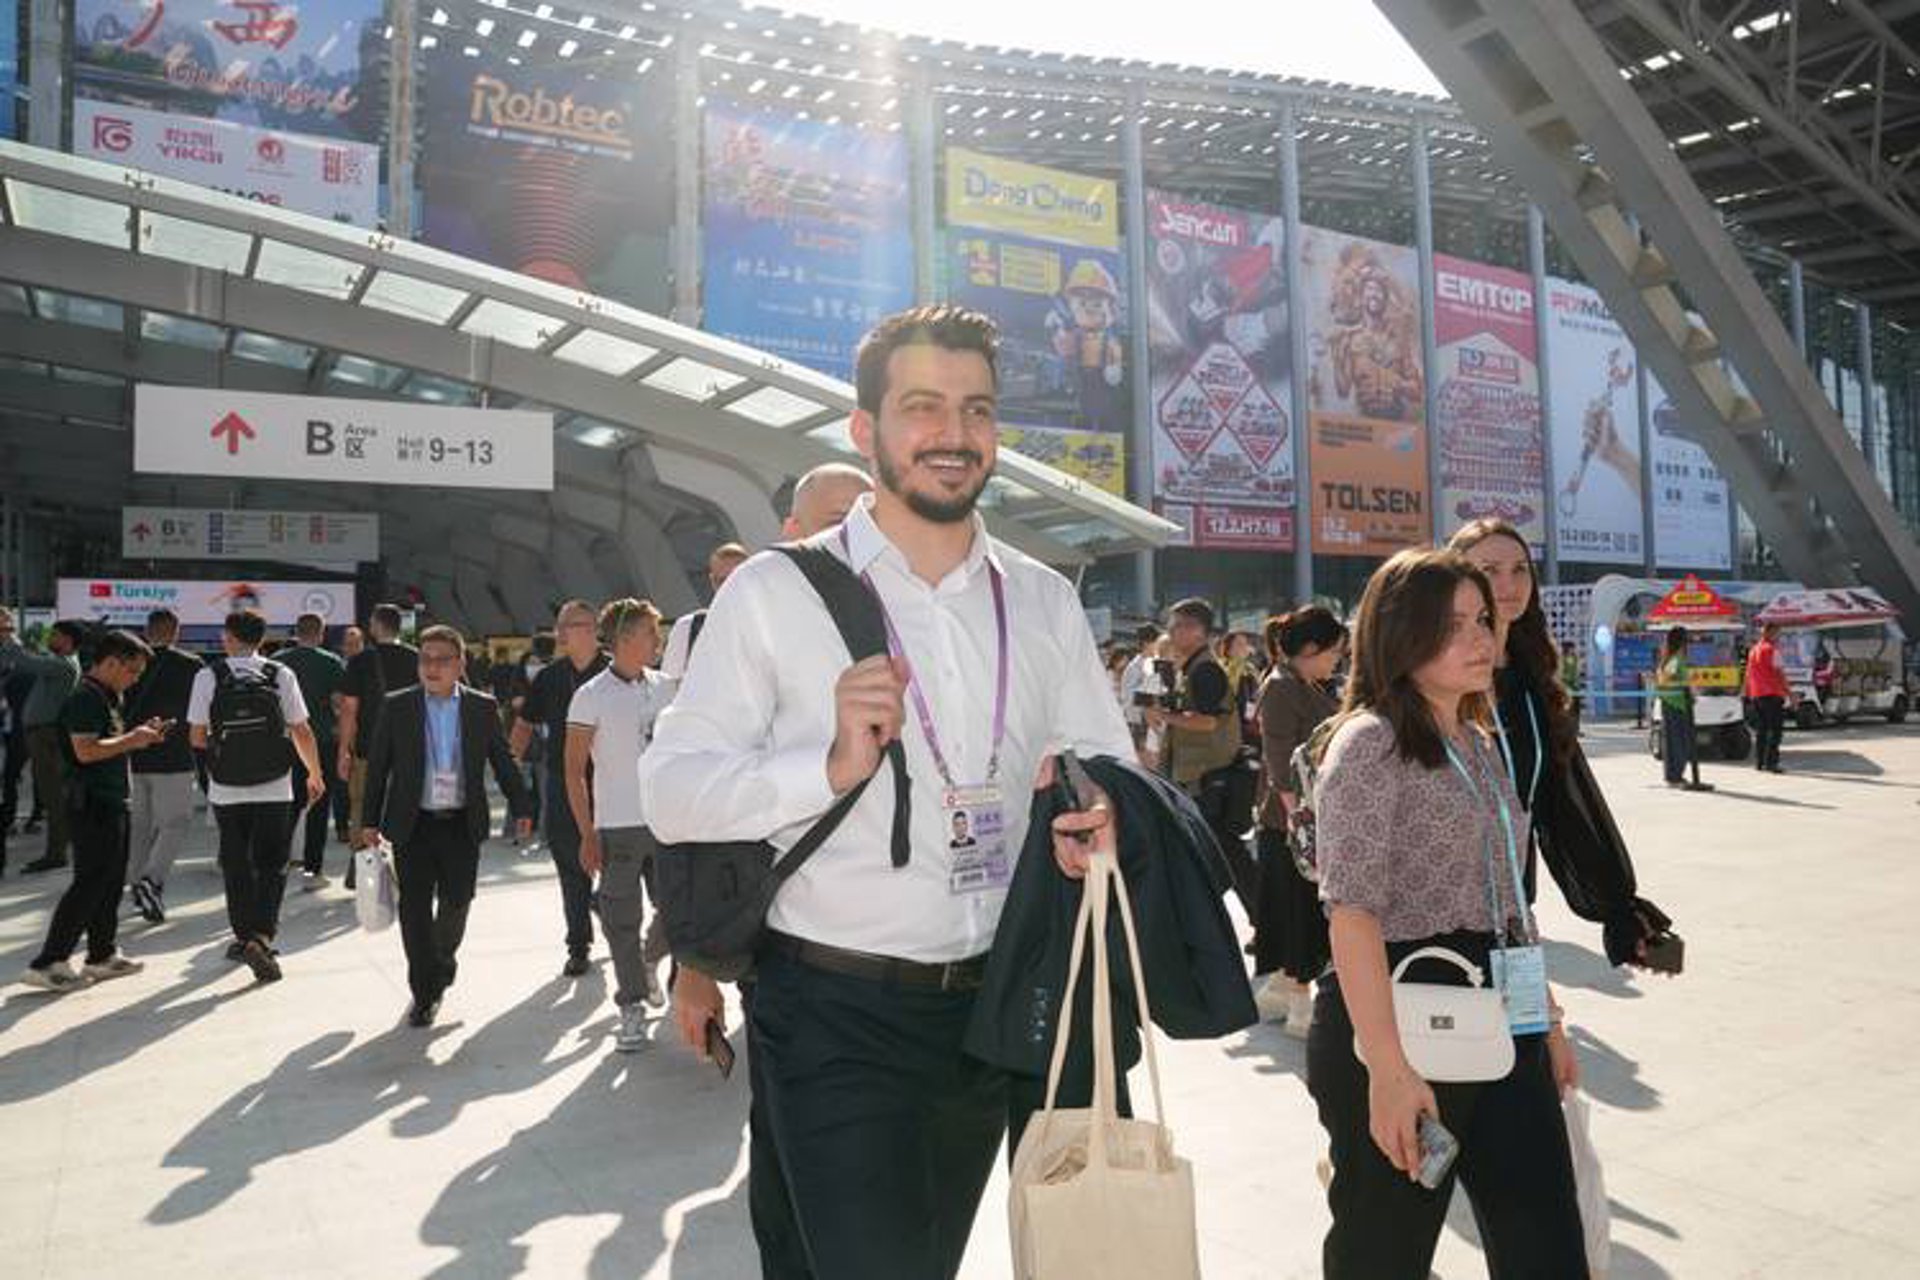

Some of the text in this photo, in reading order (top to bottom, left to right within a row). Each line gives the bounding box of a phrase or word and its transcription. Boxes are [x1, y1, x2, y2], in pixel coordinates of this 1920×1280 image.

[469, 73, 624, 133] Robtec
[1436, 271, 1532, 313] EMTOP
[306, 420, 336, 456] B
[345, 423, 378, 437] Area
[430, 437, 493, 464] 9-13
[345, 437, 365, 459] 区
[1320, 482, 1421, 513] TOLSEN
